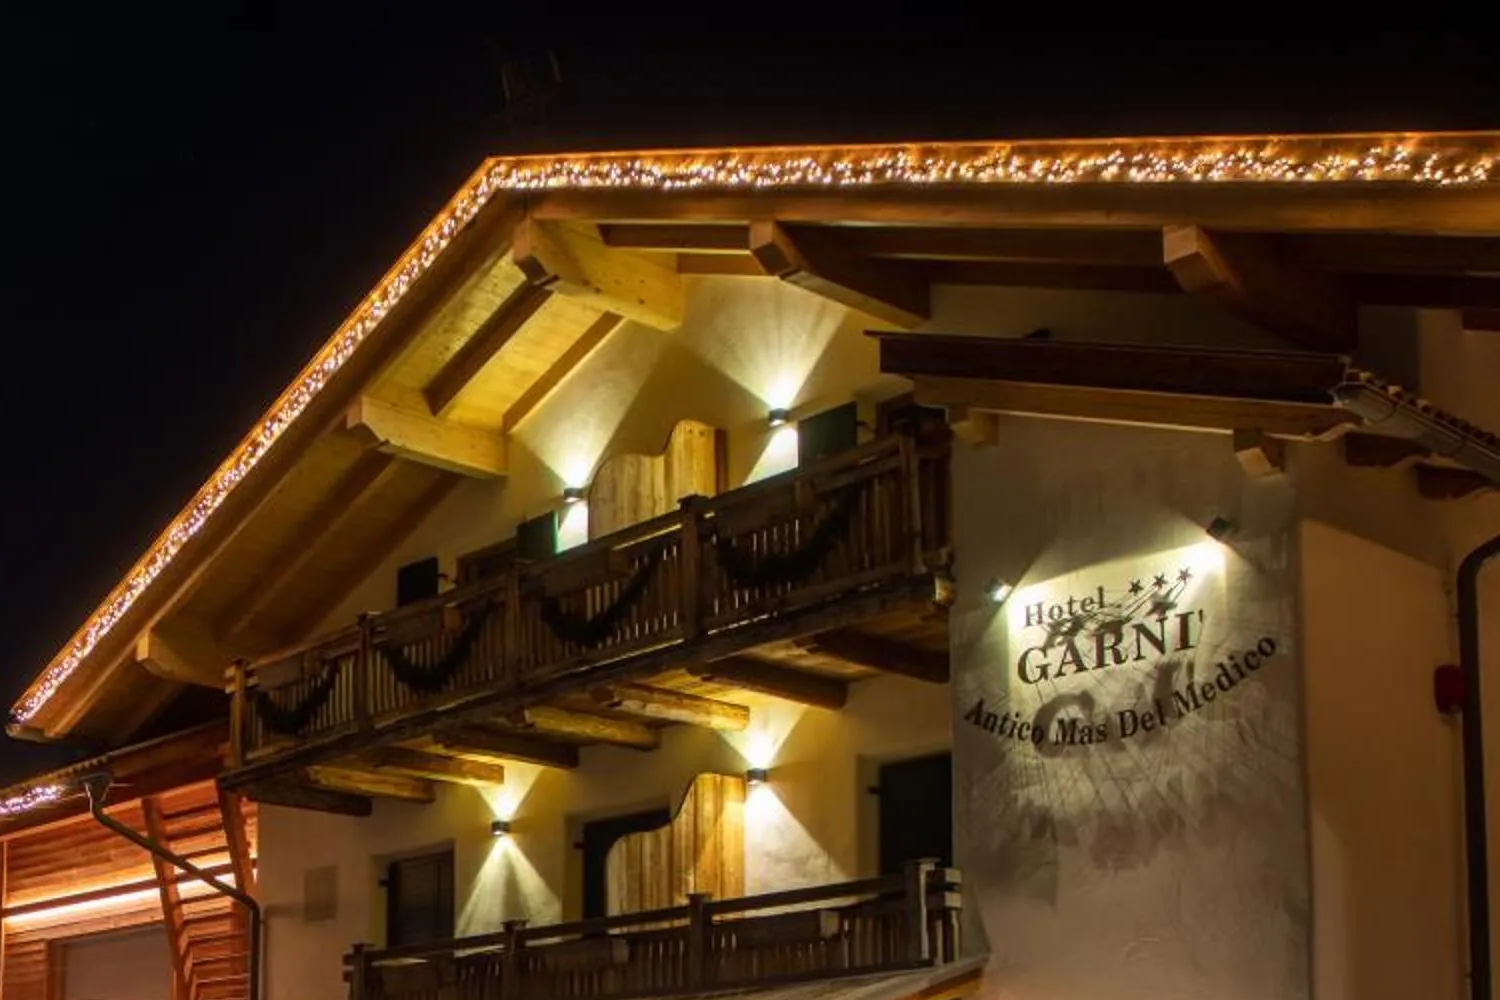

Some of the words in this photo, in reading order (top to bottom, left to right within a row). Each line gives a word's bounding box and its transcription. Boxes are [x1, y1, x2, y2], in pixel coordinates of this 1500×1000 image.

[1024, 586, 1105, 627] Hotel
[963, 698, 1046, 746] Antico
[1053, 718, 1108, 747] Mas
[1118, 703, 1166, 740] Del
[1172, 634, 1277, 718] Medico
